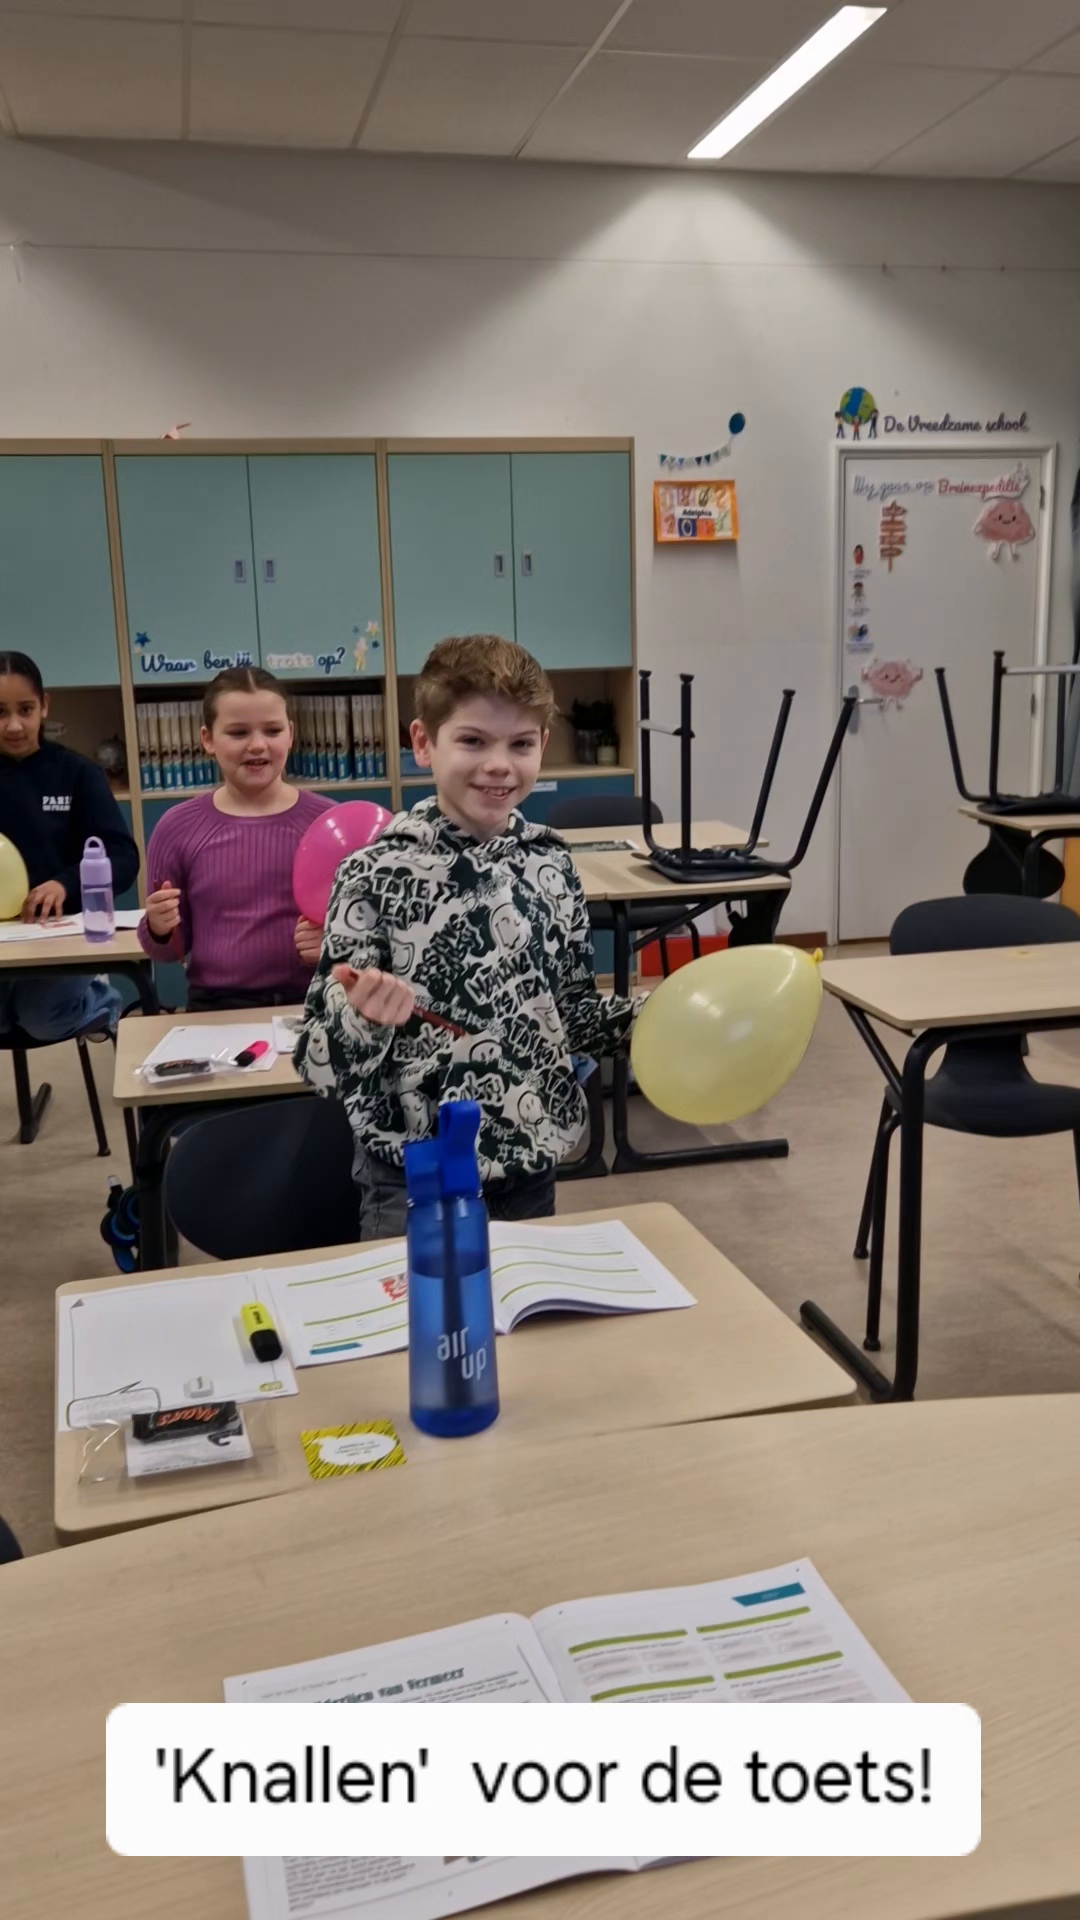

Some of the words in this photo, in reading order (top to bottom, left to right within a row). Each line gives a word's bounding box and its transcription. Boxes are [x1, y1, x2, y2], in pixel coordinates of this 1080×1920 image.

[884, 415, 904, 432] De
[907, 413, 982, 432] Vreedzame
[141, 655, 196, 673] Waar
[203, 650, 233, 669] ben
[318, 647, 346, 674] op?
[372, 875, 430, 901] TAKE
[380, 895, 438, 931] EASY
[436, 1326, 469, 1361] air
[461, 1347, 487, 1381] up
